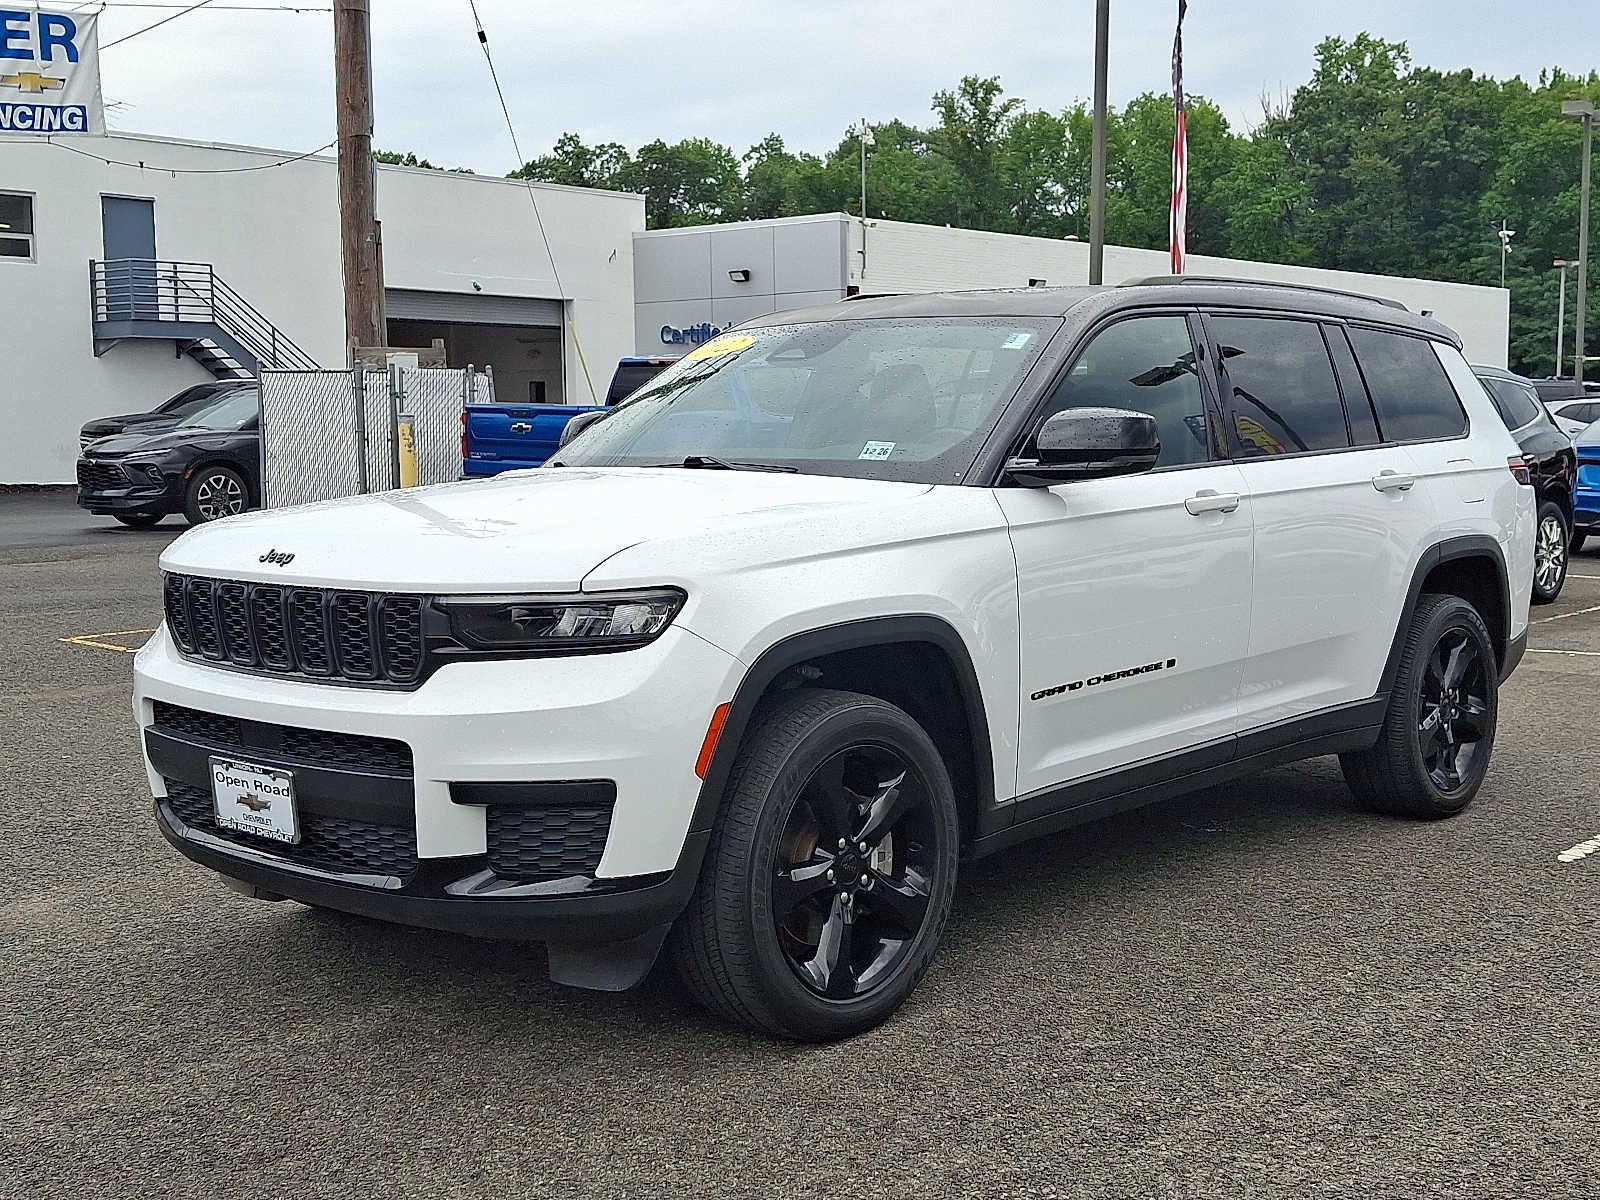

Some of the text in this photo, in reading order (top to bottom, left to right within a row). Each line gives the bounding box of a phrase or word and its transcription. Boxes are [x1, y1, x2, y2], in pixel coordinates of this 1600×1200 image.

[0, 9, 79, 63] ER
[0, 104, 84, 130] NCING
[258, 548, 296, 568] Jeep
[1030, 680, 1083, 701] GRAND
[1086, 661, 1164, 687] CHEROKEE
[216, 771, 290, 797] Open Road
